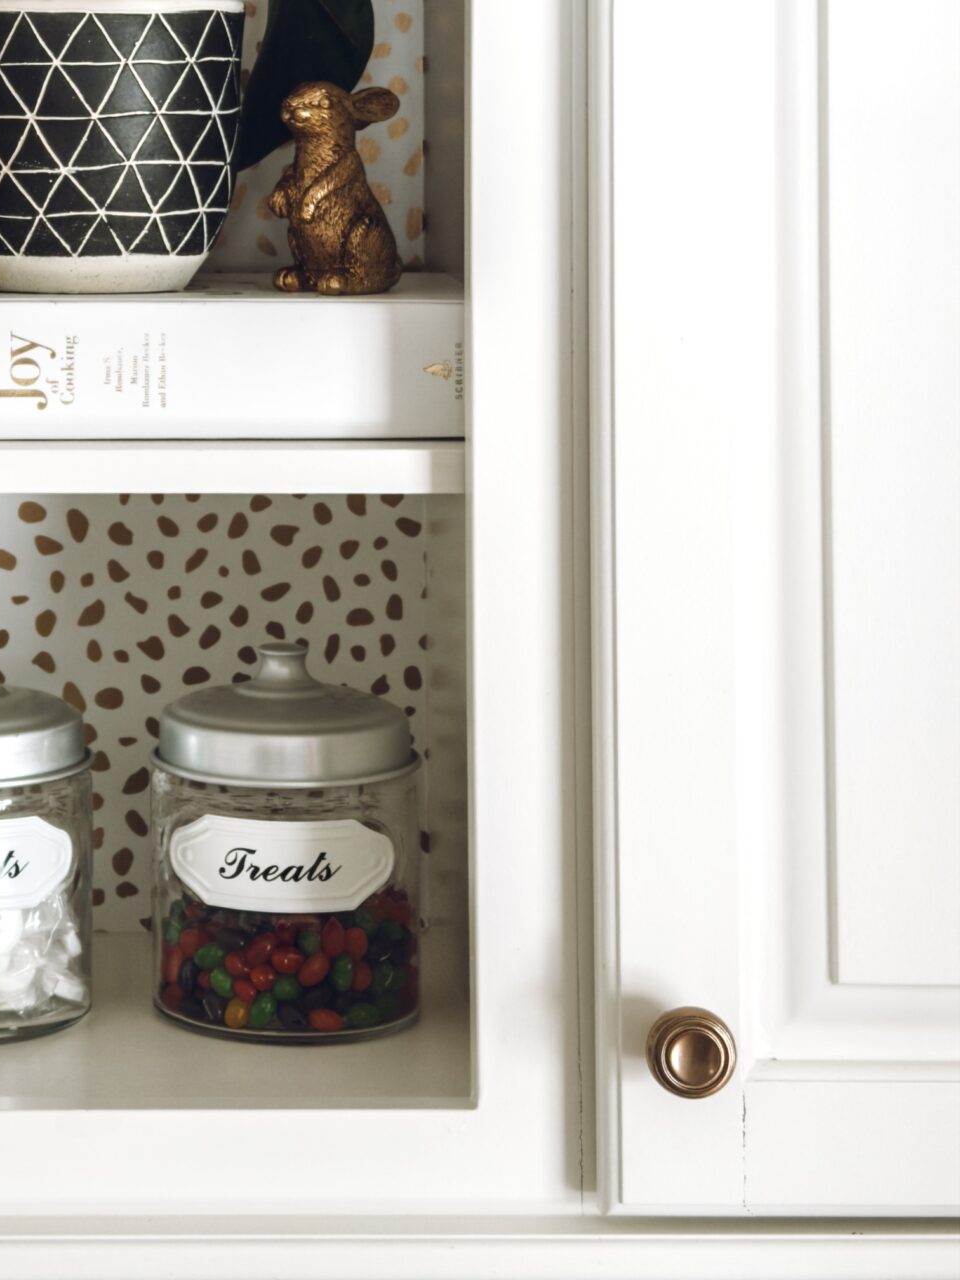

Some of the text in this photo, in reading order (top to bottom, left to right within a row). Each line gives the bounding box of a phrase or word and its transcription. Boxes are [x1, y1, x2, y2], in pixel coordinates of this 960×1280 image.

[45, 376, 60, 394] of
[58, 334, 80, 406] Cooking
[455, 342, 463, 399] SCRIBNER
[218, 847, 343, 883] Treats
